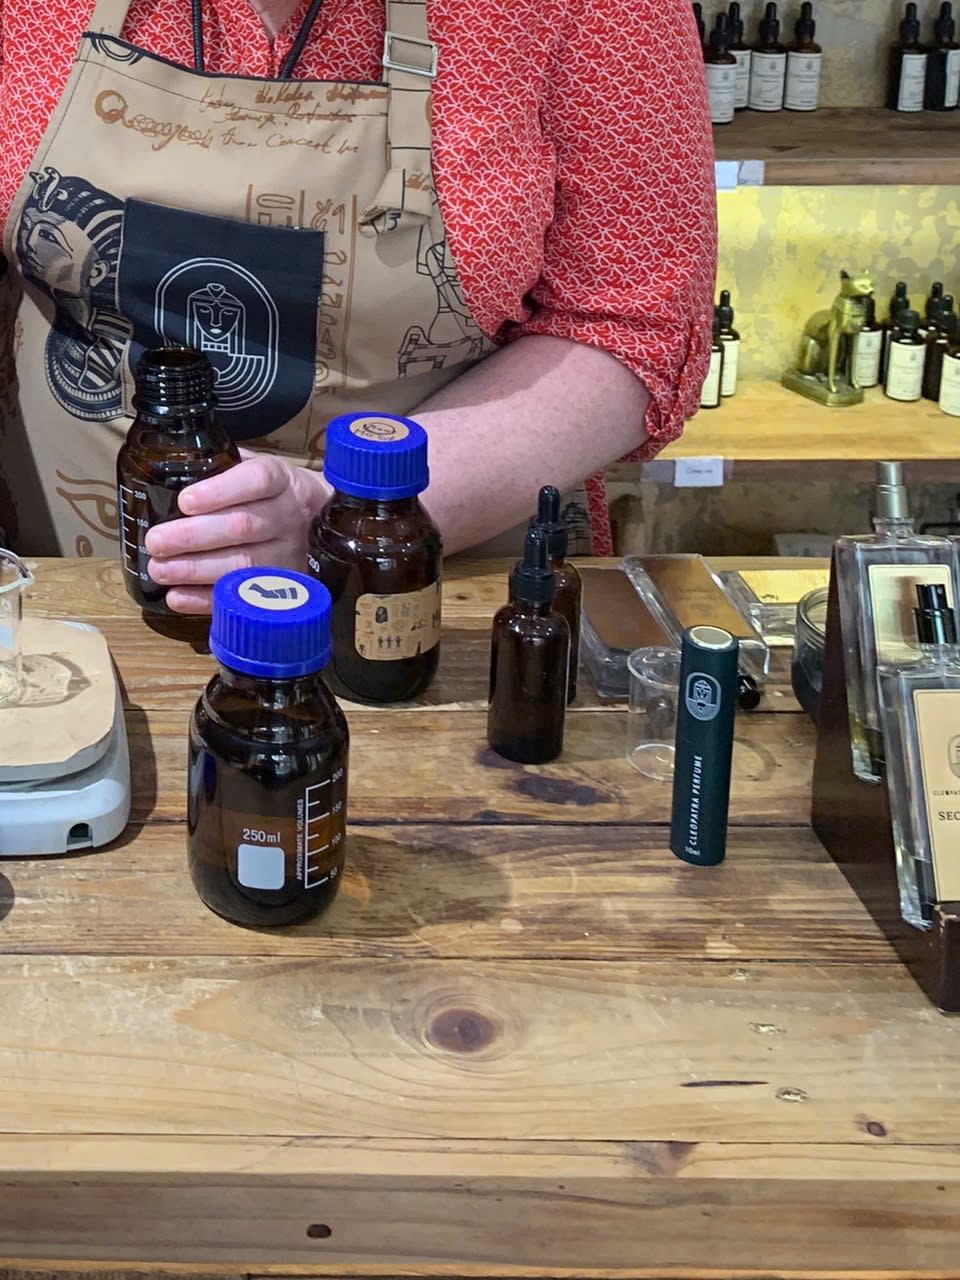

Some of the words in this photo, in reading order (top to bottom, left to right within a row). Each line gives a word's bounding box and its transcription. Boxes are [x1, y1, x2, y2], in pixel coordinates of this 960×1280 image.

[134, 490, 147, 500] 200
[136, 518, 149, 528] 150
[692, 755, 703, 795] PERFUME
[688, 797, 700, 846] CLEOPATRA
[242, 828, 281, 843] 250ml
